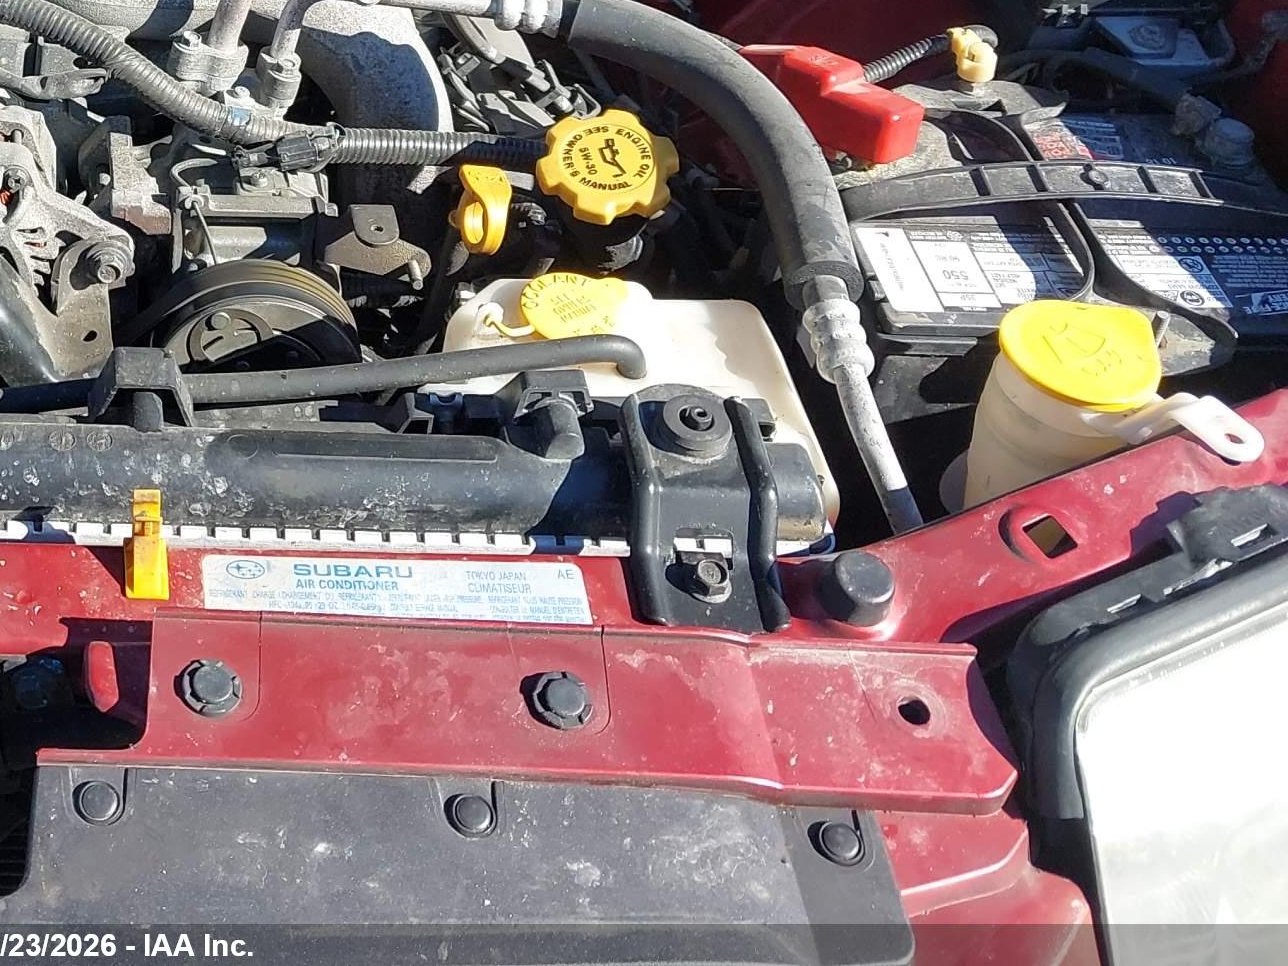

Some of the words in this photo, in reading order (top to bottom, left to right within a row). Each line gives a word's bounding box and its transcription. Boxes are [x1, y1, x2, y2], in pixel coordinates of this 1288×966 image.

[585, 125, 610, 136] SEE
[615, 128, 652, 161] ENGINE
[562, 134, 583, 177] OWNER'S
[578, 147, 598, 176] 5W-30
[633, 163, 651, 179] OIL
[579, 177, 632, 191] MANUAL
[942, 269, 969, 280] 550
[522, 274, 592, 310] COOLANT
[293, 563, 413, 579] SUBARU
[557, 569, 575, 580] AE
[296, 579, 315, 589] AIR
[318, 579, 399, 591] CONDITIONER
[468, 583, 532, 594] CLIMATISEUR
